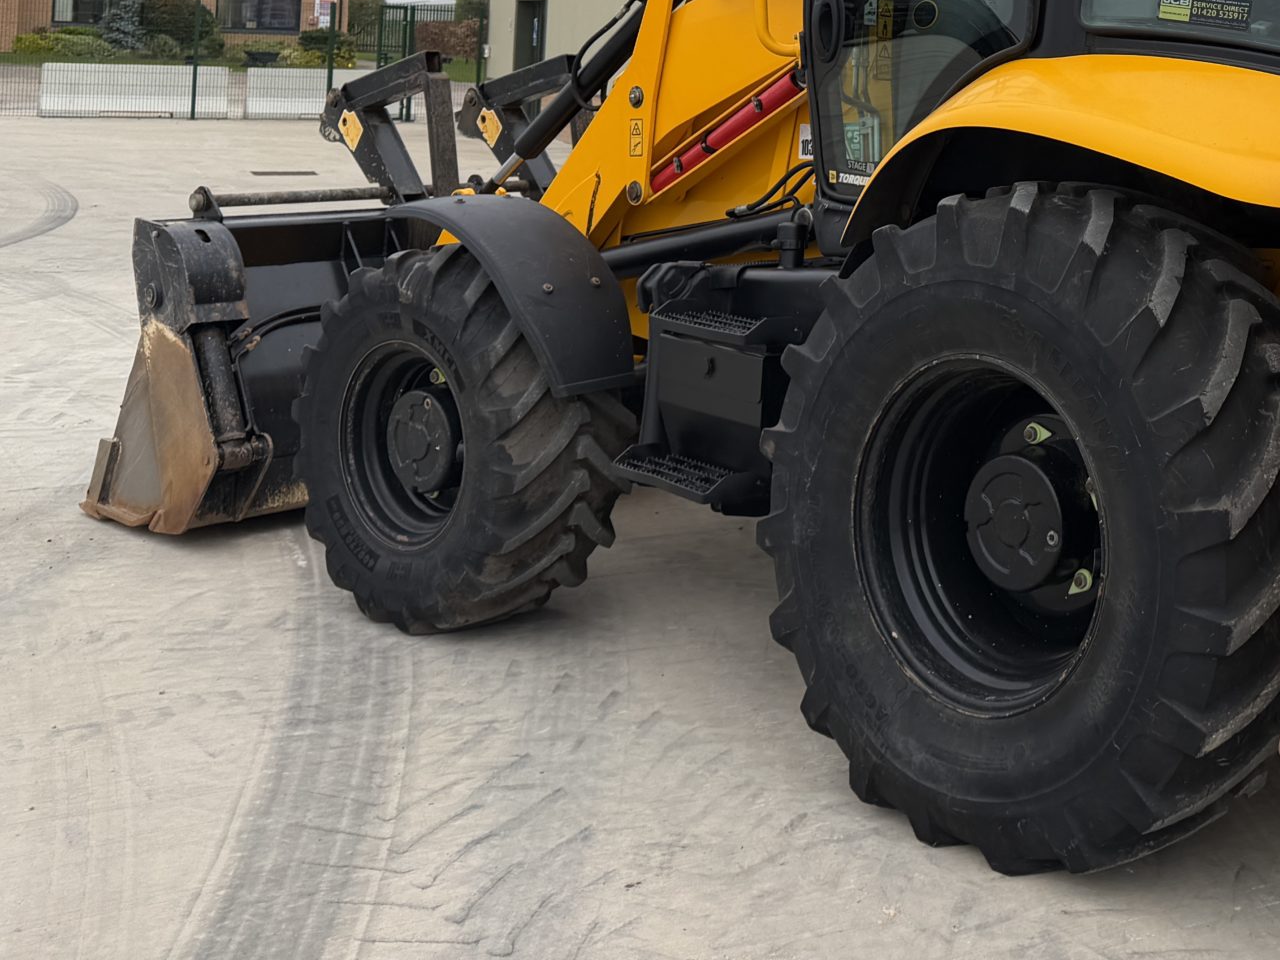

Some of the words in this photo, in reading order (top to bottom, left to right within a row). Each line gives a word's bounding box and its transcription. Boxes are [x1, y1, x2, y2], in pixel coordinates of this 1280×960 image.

[1192, 7, 1217, 17] 01420
[1218, 11, 1248, 21] 525917
[1193, 0, 1222, 11] SERVICE
[1223, 4, 1249, 14] DIRECT
[847, 160, 866, 172] STAGE
